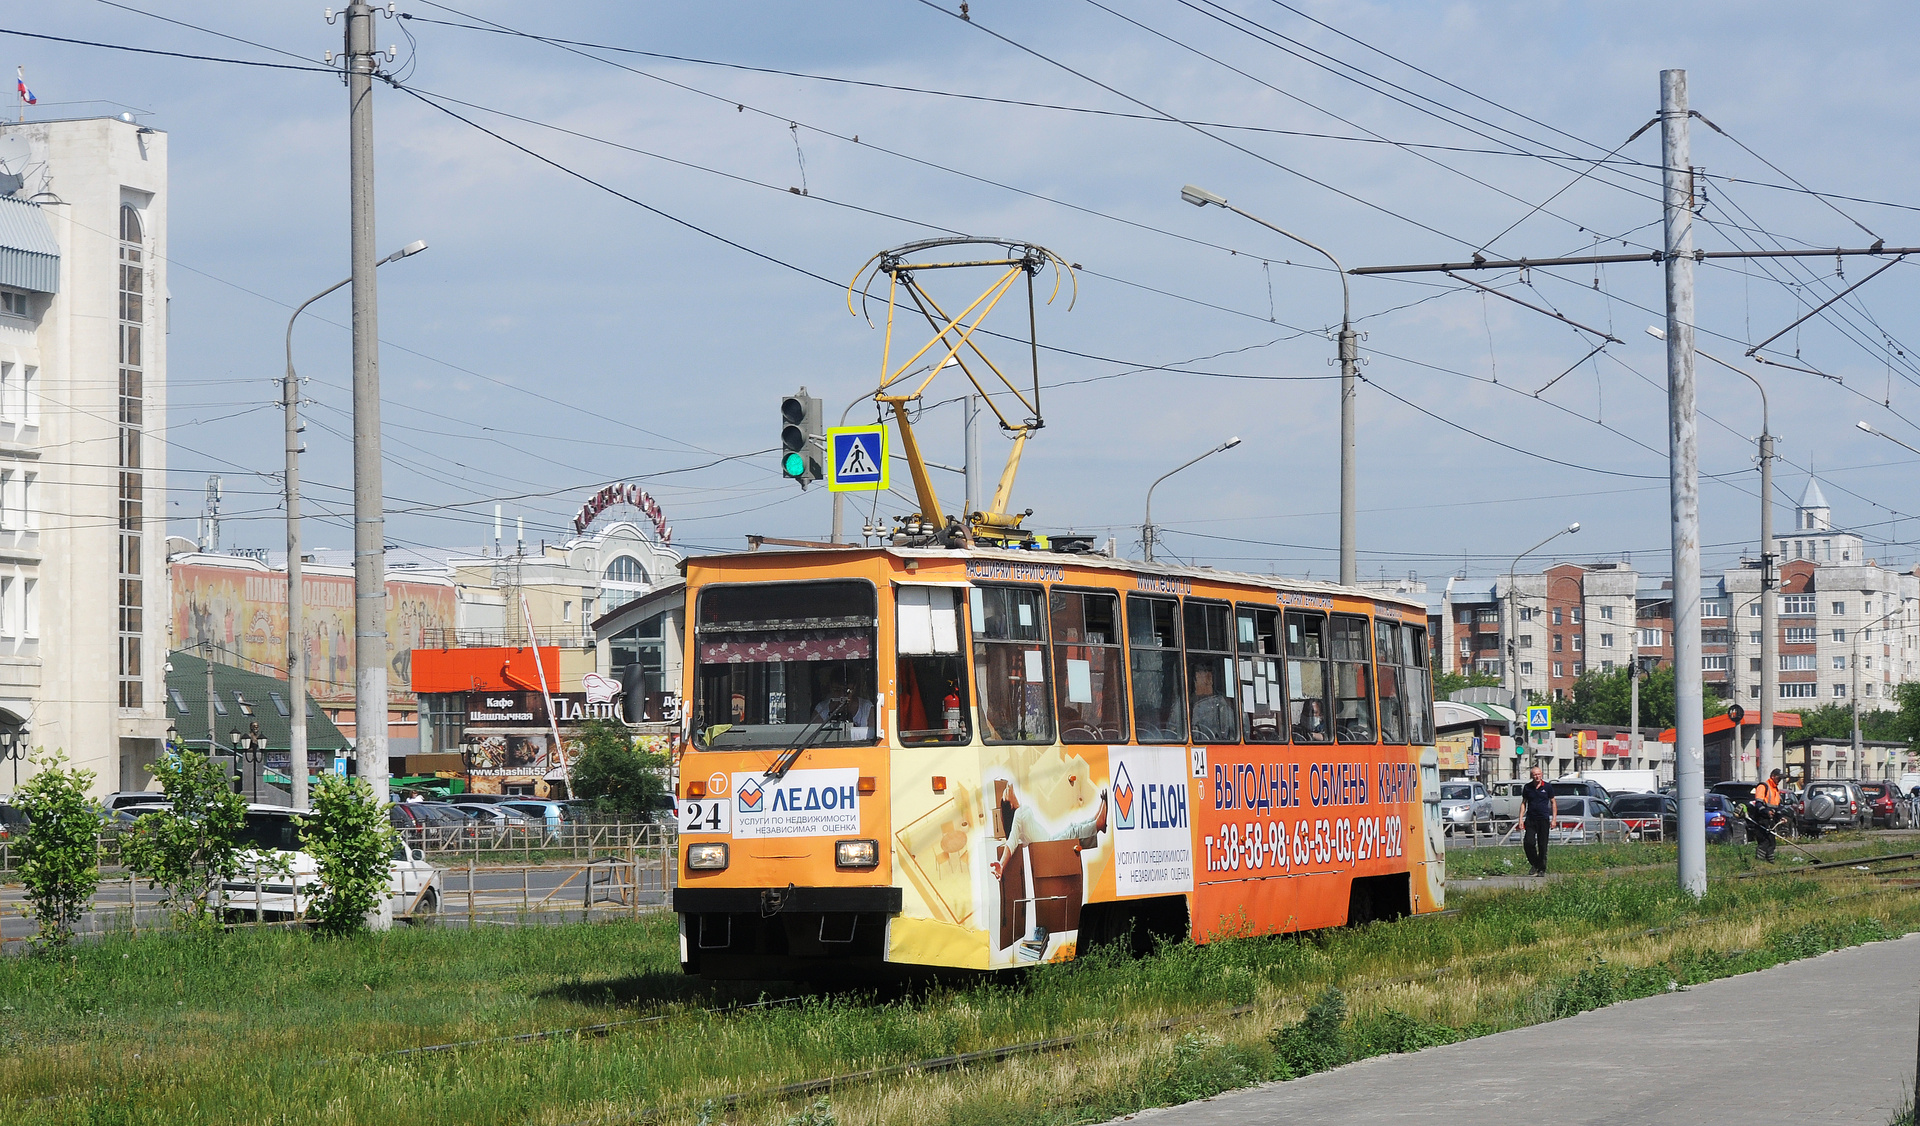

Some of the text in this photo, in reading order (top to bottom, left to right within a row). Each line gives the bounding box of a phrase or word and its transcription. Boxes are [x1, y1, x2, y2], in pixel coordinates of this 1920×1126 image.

[1012, 562, 1065, 582] ТЕРРИТОРИЮ
[245, 576, 289, 604] ПЛАНЕ
[303, 580, 354, 611] ОДЕЖДА
[1136, 573, 1192, 595] www.ledon.ru
[486, 697, 514, 709] Кафе
[470, 711, 533, 722] Шашлычная
[1193, 751, 1205, 775] 24
[771, 786, 855, 812] ЛЕДОН
[1214, 763, 1418, 816] ВЫГОДНЫЕ ОБМЕНЫ КВАРТИР
[686, 803, 721, 831] 24
[1141, 784, 1188, 829] ЛЕДОН
[739, 814, 857, 826] УСЛУГИ ПО НЕДВИЖИМОСТИ
[755, 825, 816, 835] НЕЗАВИСИМАЯ
[822, 824, 857, 833] ОЦЕНКА
[1293, 817, 1355, 867] 63-53-03;
[1357, 815, 1402, 860] 291-292
[1117, 849, 1190, 865] УСЛУГИ ПО НЕДВИЖИМОСТИ
[1130, 868, 1168, 883] НЕЗАВИСИМАЯ
[1171, 867, 1191, 882] ОЦЕНКА
